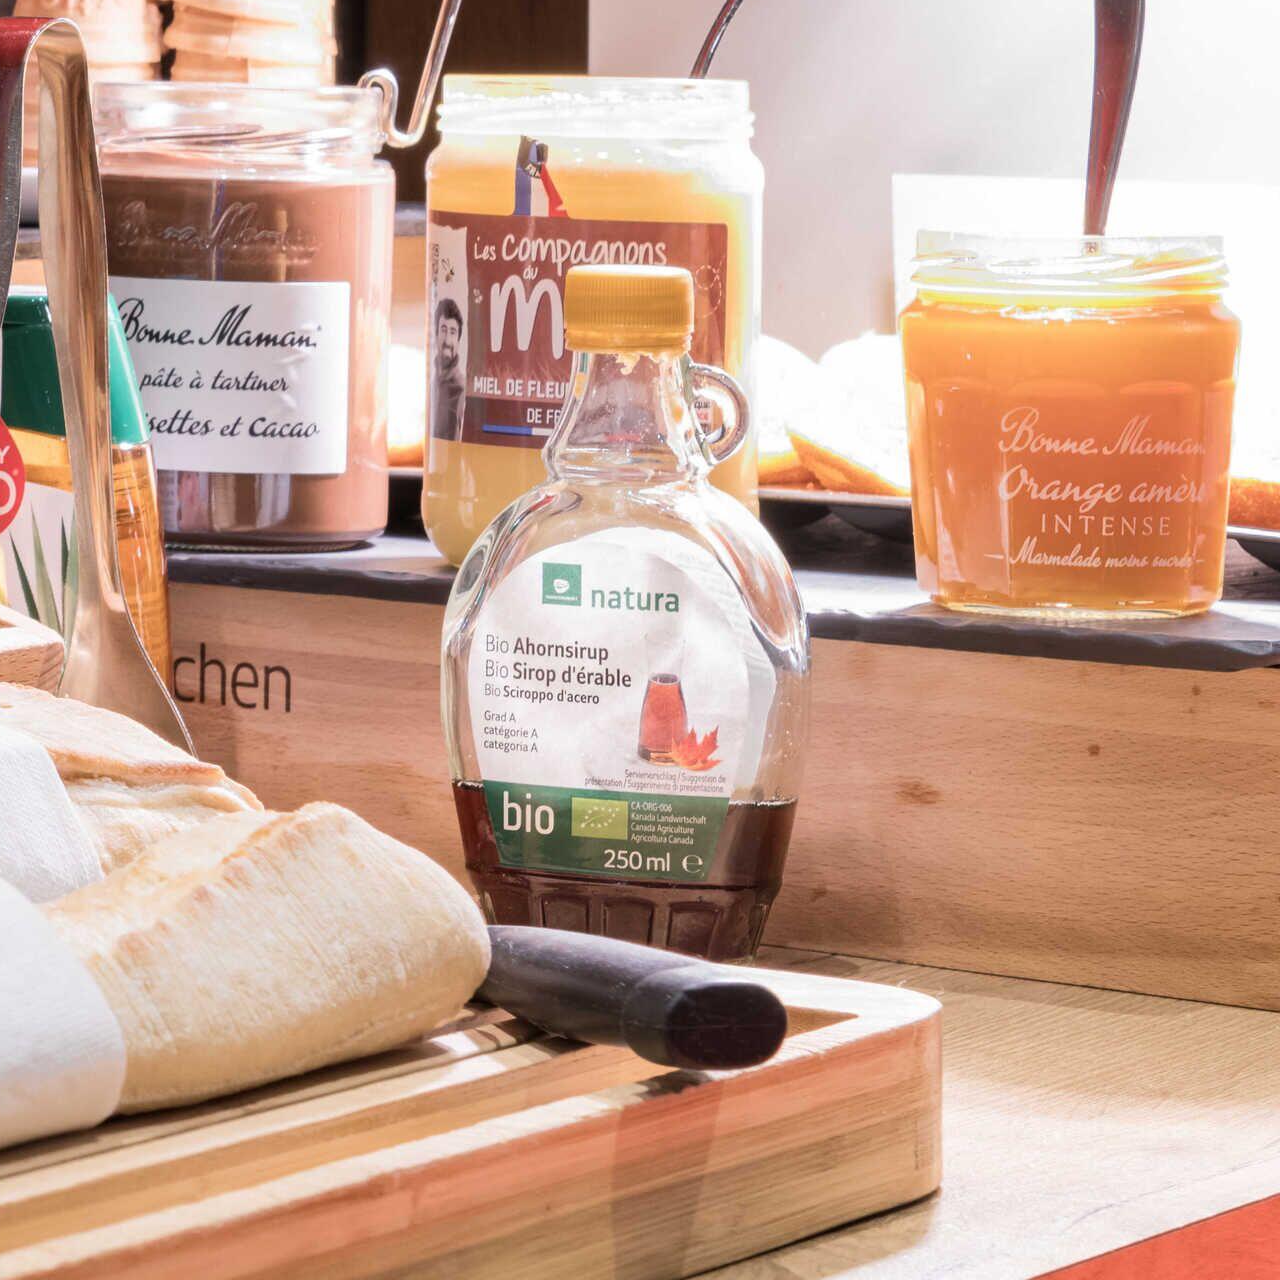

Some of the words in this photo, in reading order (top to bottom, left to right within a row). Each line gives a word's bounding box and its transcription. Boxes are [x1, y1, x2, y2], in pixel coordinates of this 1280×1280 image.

[473, 237, 496, 261] Les
[501, 233, 668, 276] Compagnons
[523, 265, 538, 280] du
[118, 297, 194, 345] Bonne
[199, 303, 317, 348] Maman
[139, 367, 184, 392] pâte
[190, 369, 204, 389] à
[211, 369, 289, 392] tartiner
[474, 375, 501, 395] MIEL
[506, 378, 523, 396] DE
[527, 380, 570, 399] FLEU
[220, 416, 244, 437] et
[248, 417, 319, 438] Cacao
[526, 408, 542, 424] DE
[998, 406, 1098, 455] Bonne
[1102, 414, 1206, 456] Maman
[998, 463, 1123, 513] Orange
[1041, 513, 1171, 537] INTENSE
[1009, 535, 1101, 569] Marmelade
[1105, 555, 1150, 569] moins
[591, 586, 680, 613] natura
[486, 634, 509, 654] Bio
[513, 637, 609, 665] Ahornsirup
[173, 641, 291, 713] chen
[485, 659, 509, 679] Bio
[512, 661, 556, 686] Sirop
[561, 665, 632, 688] d'érable
[484, 683, 501, 697] Bio
[503, 685, 554, 704] Sciroppo
[557, 689, 600, 705] d'acero
[484, 710, 507, 722] Grad
[508, 712, 517, 723] A
[483, 724, 529, 739] catégorie
[530, 728, 539, 739] A
[483, 739, 529, 754] categoria
[530, 742, 539, 753] A
[503, 791, 555, 835] bio
[631, 812, 656, 823] Kanada
[657, 814, 707, 826] Landwirtschaft
[630, 822, 656, 833] Canada
[657, 825, 694, 836] Agriculture
[630, 831, 667, 844] Agricoltura
[668, 834, 694, 846] Canada
[604, 849, 642, 872] 250
[646, 850, 671, 873] ml
